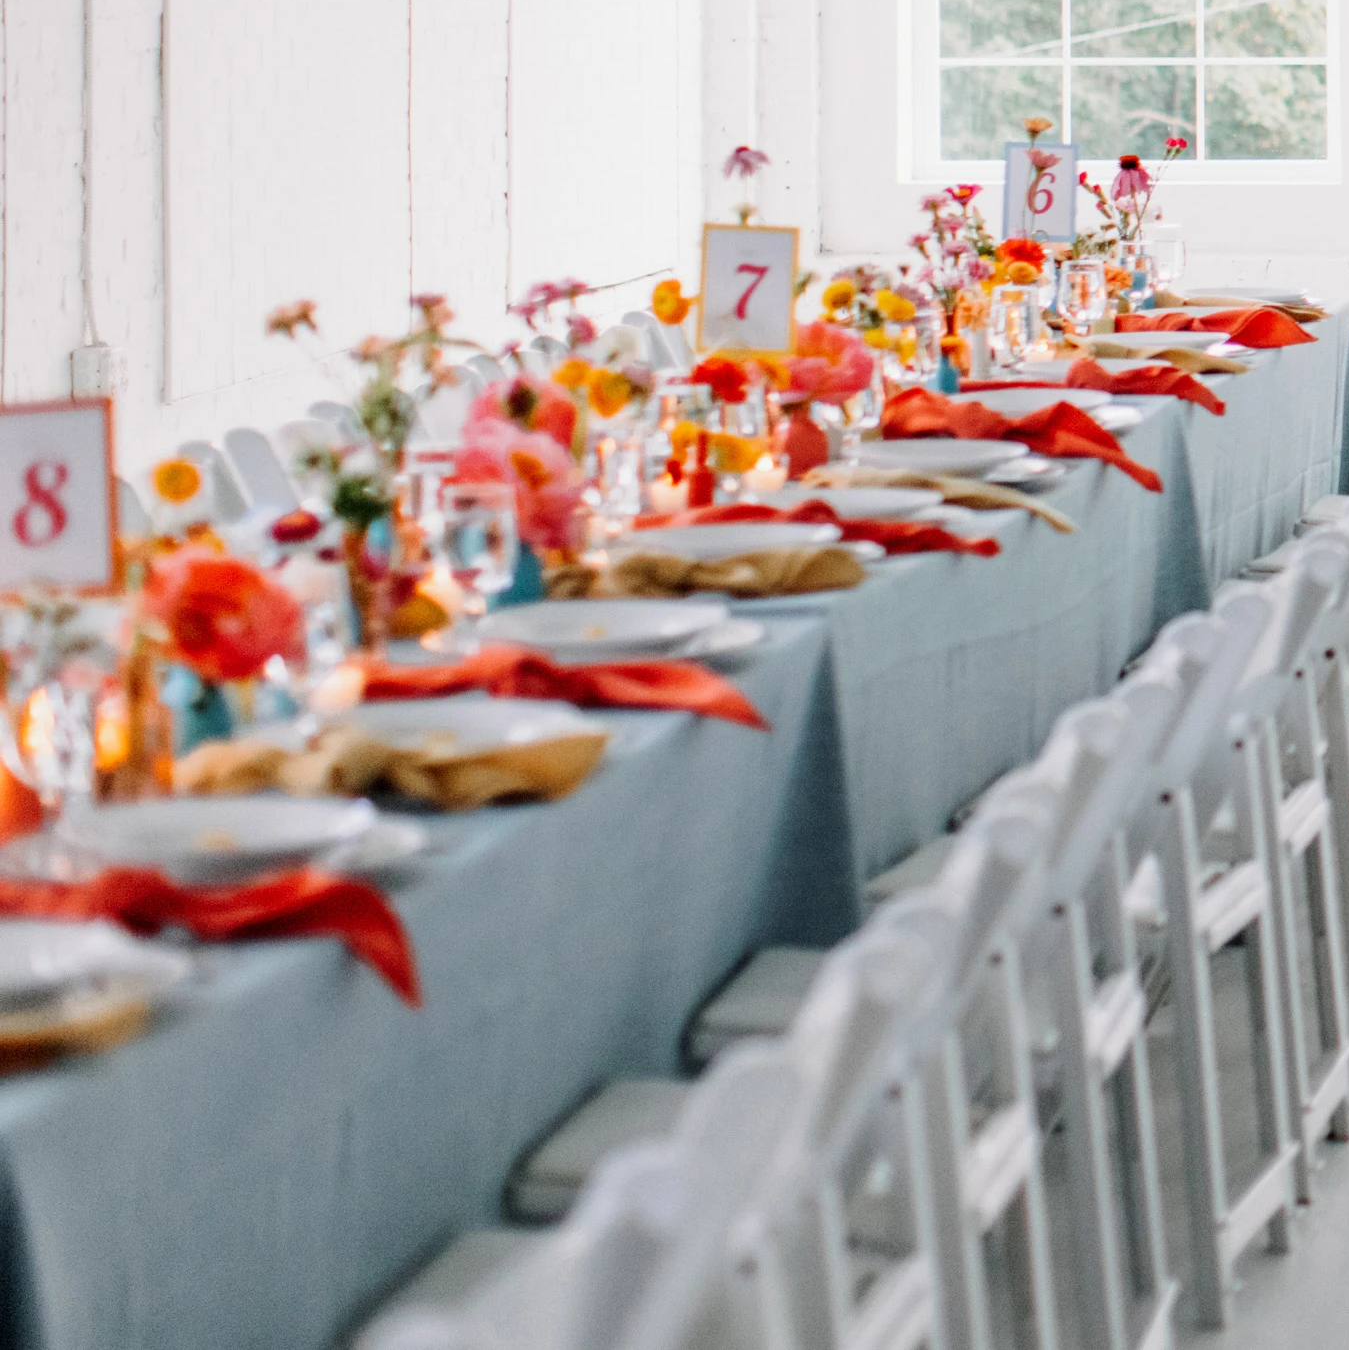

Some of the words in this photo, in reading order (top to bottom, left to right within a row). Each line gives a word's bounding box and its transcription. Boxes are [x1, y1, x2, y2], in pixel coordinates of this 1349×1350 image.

[1027, 171, 1056, 214] 6
[735, 263, 769, 320] 7
[12, 460, 69, 547] 8
